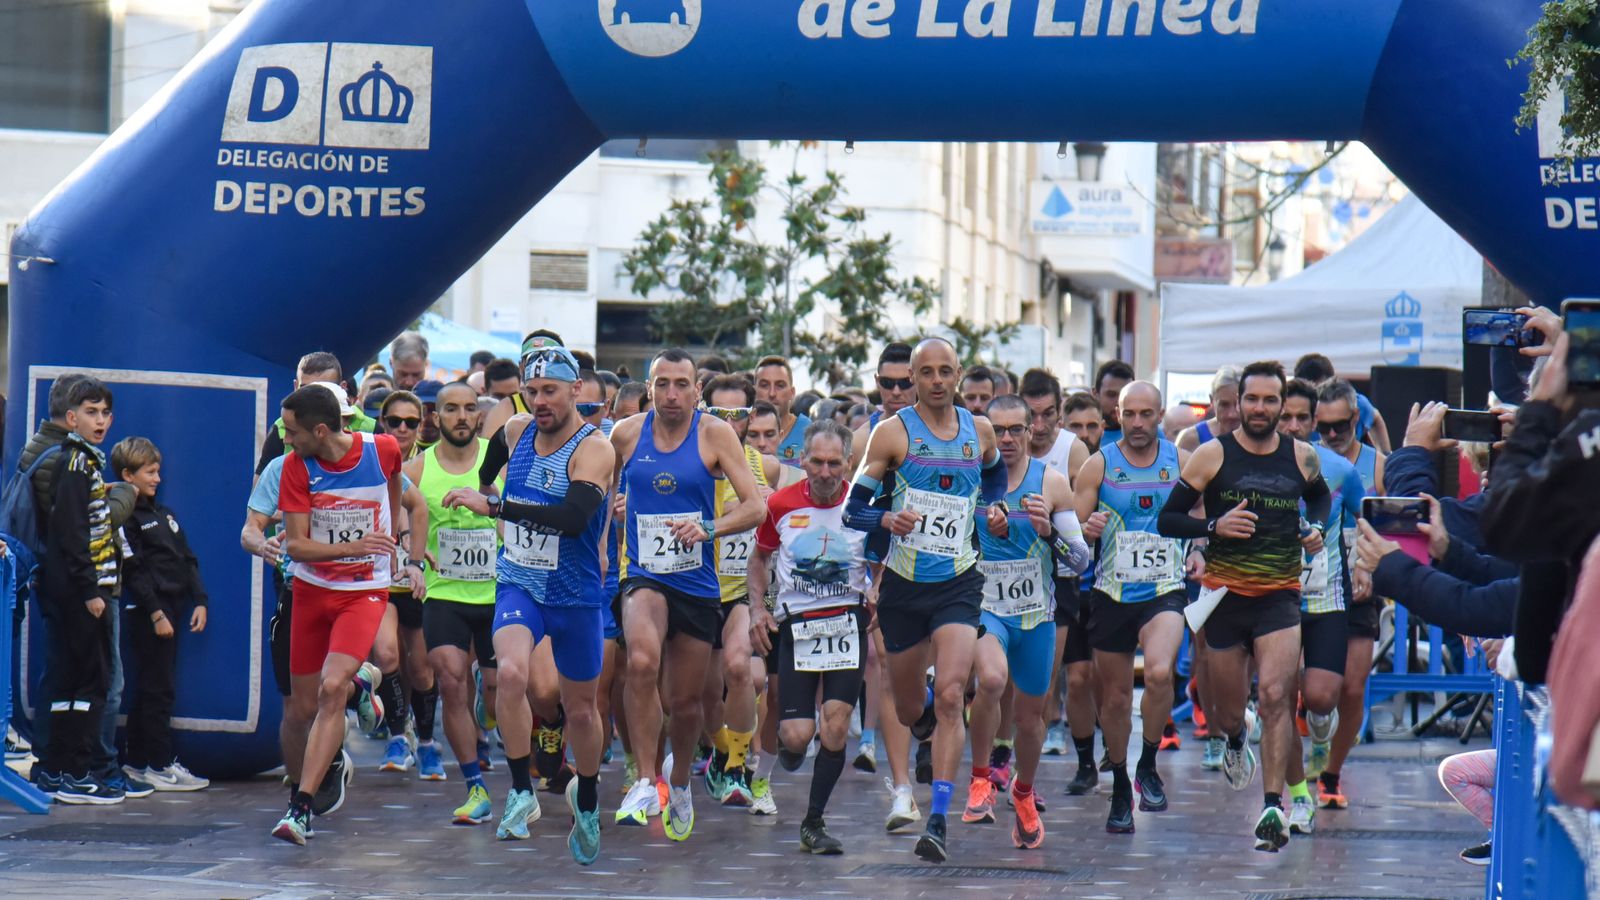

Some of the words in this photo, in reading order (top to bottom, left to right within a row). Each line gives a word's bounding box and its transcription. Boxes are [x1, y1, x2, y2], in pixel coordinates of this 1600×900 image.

[797, 0, 895, 39] de
[916, 0, 1011, 38] La
[247, 66, 299, 122] D
[217, 149, 353, 172] DELEGACIÓN
[360, 155, 389, 173] DE
[214, 180, 426, 217] DEPORTES
[514, 525, 549, 551] 137
[919, 514, 958, 539] 156
[452, 548, 489, 567] 200
[1131, 549, 1167, 569] 155
[996, 578, 1034, 600] 160
[811, 635, 851, 655] 216
